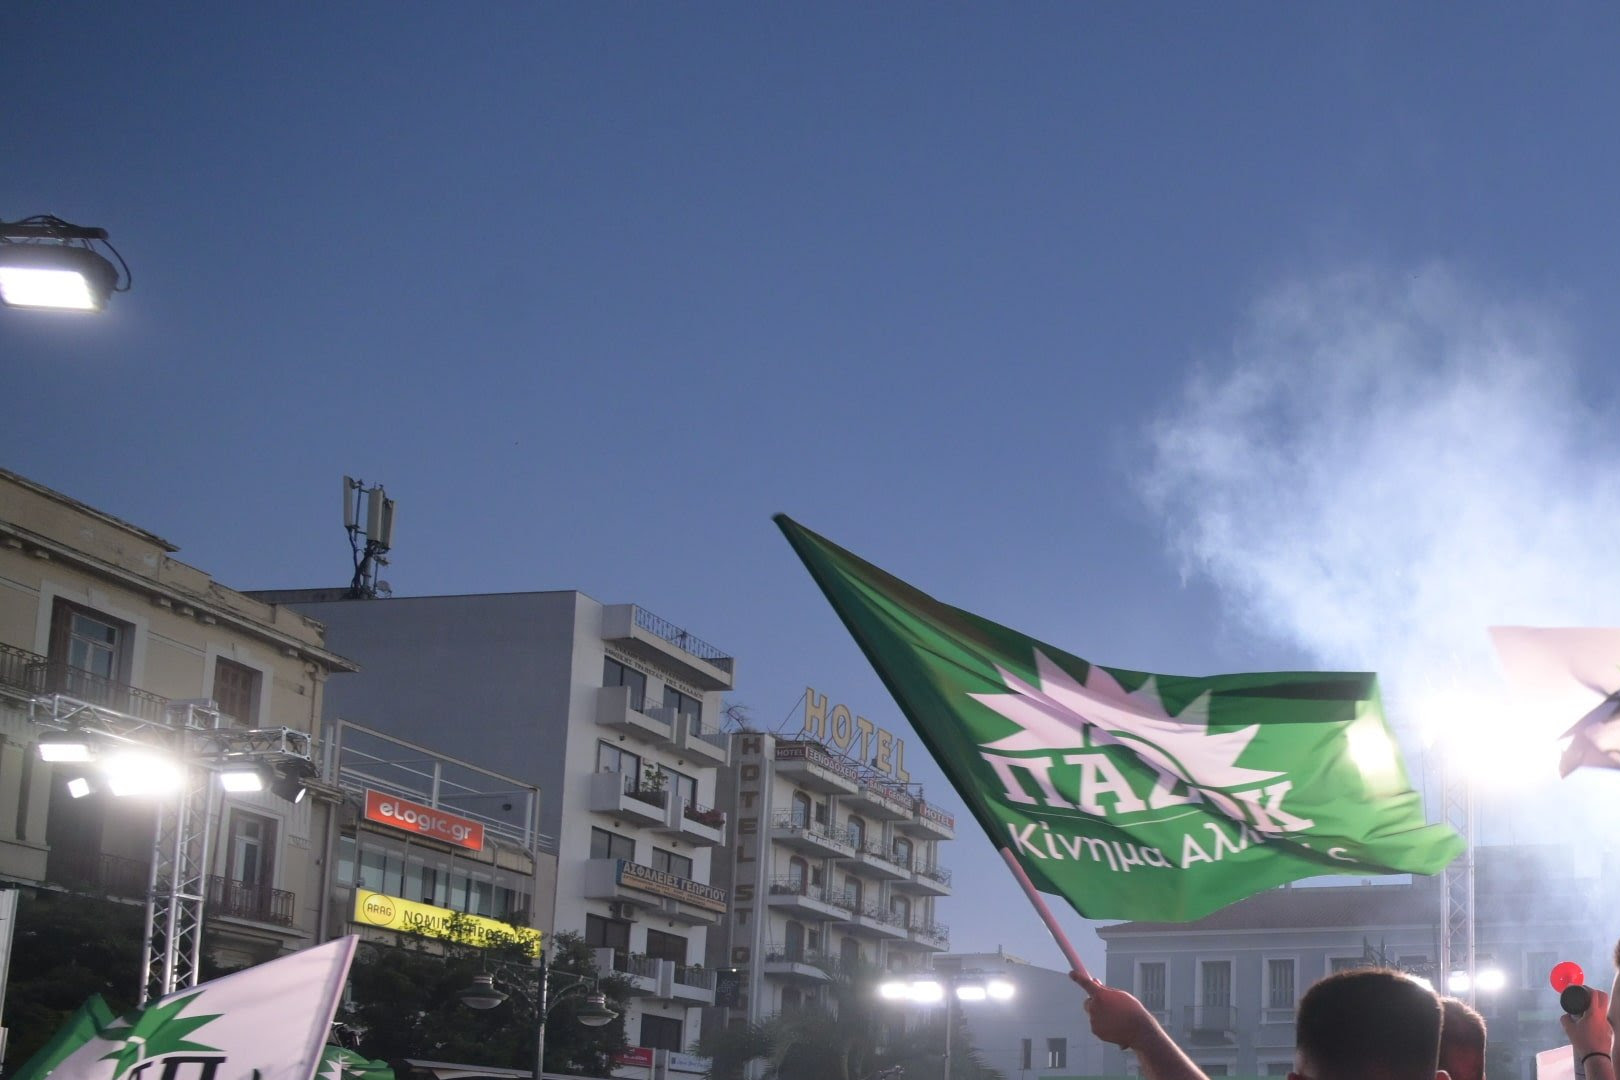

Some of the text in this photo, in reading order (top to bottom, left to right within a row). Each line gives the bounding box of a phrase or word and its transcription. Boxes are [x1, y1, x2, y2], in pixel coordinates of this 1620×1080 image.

[804, 686, 911, 784] HOTEL
[777, 748, 804, 758] HOTEL
[808, 748, 857, 780] ΞΕΝΟΔΟΧΕΙΟ
[379, 801, 473, 841] eLogic.gr
[924, 806, 951, 827] HOTEL
[1007, 811, 1360, 874] Κίνημα Αλλς
[623, 861, 679, 888] ΑΣΦΑΛΕΙΕΣ
[681, 879, 726, 902] ΓΕΩΡΓΙΟΥ
[367, 902, 392, 917] ARAG
[404, 909, 458, 931] ΝΟΜΙΚ
